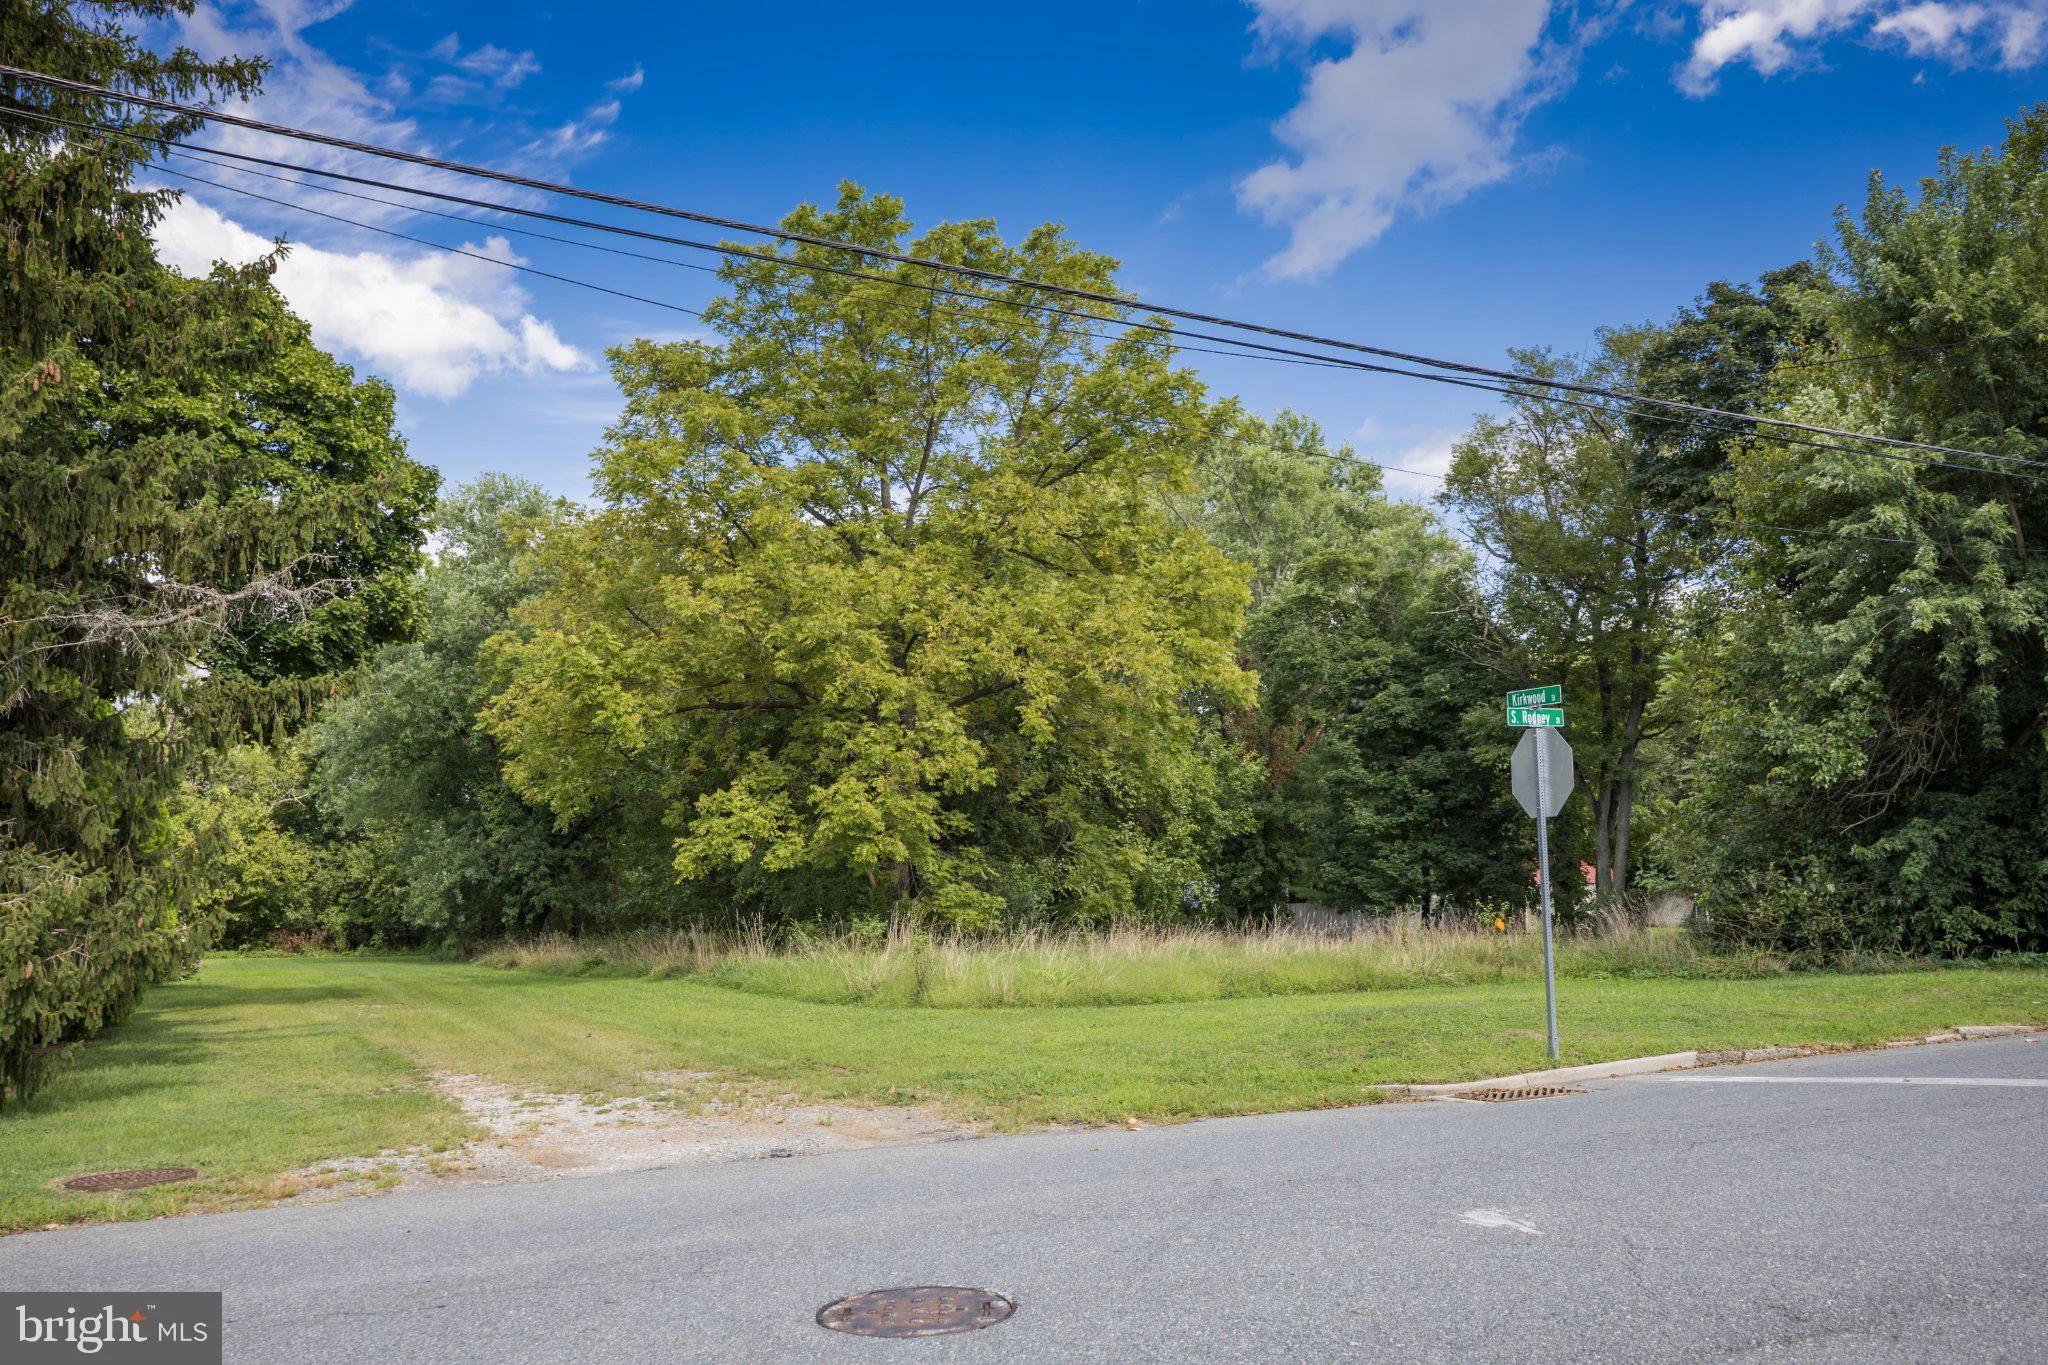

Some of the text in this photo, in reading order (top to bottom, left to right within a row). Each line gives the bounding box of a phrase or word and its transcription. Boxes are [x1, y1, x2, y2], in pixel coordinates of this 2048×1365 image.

[1511, 690, 1546, 707] Kirkwood
[1511, 710, 1519, 723] S.
[1522, 710, 1551, 725] Rodney
